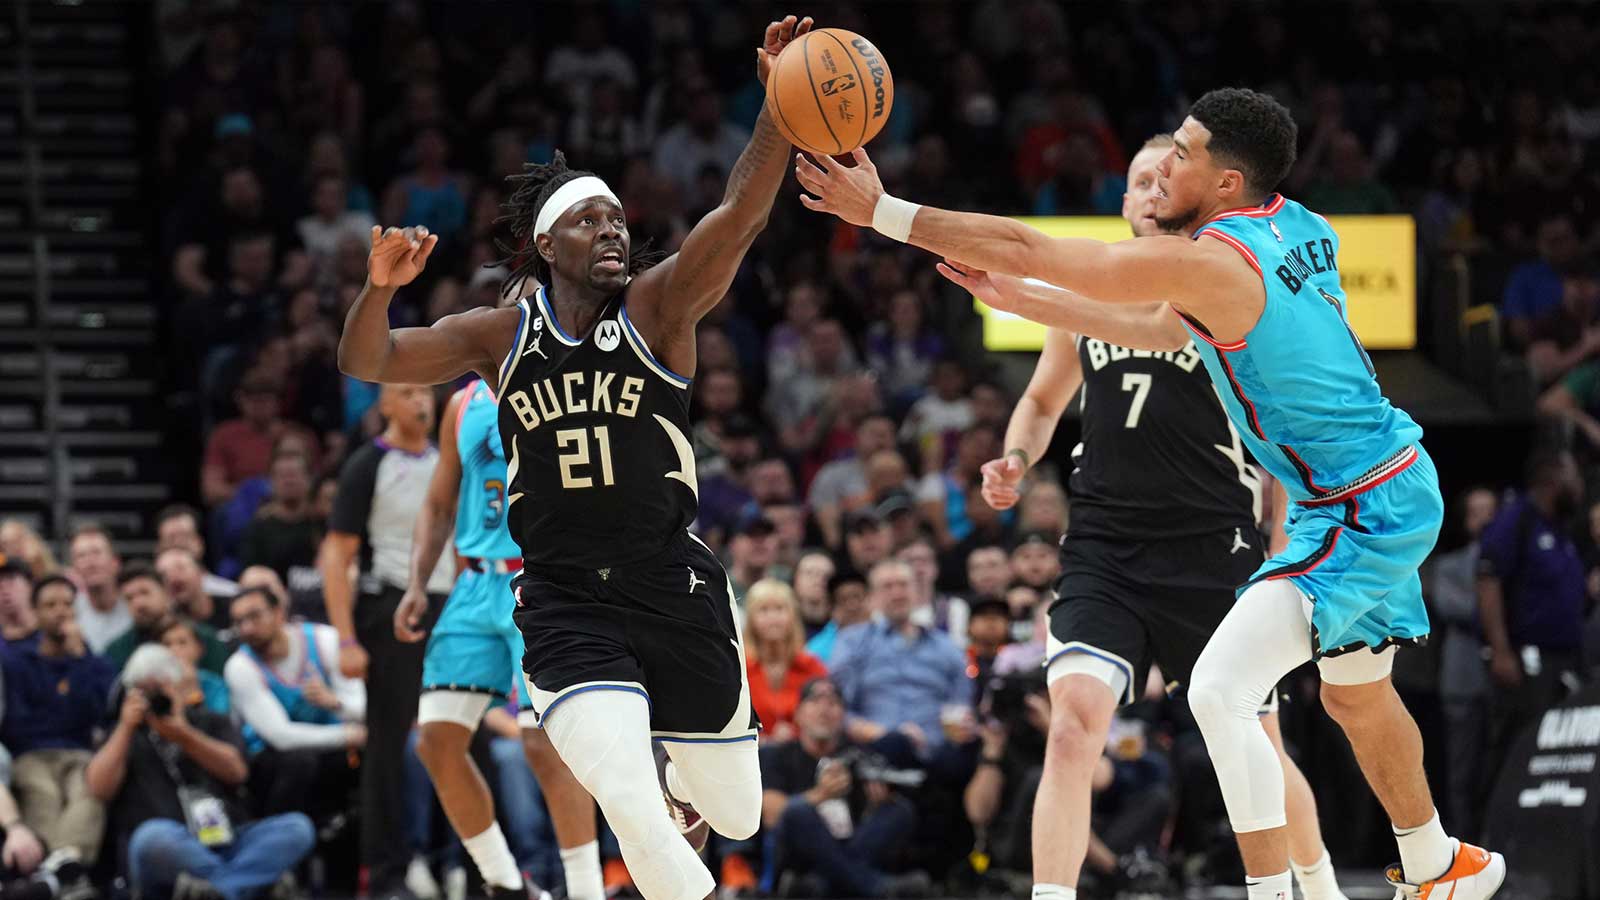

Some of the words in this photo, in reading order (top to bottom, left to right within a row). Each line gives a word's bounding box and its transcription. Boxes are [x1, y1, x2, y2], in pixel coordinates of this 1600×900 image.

[851, 39, 884, 119] Wilson
[533, 316, 543, 331] 6
[507, 370, 645, 431] BUCKS
[1121, 373, 1152, 429] 7
[556, 425, 615, 489] 21
[484, 479, 504, 530] 3
